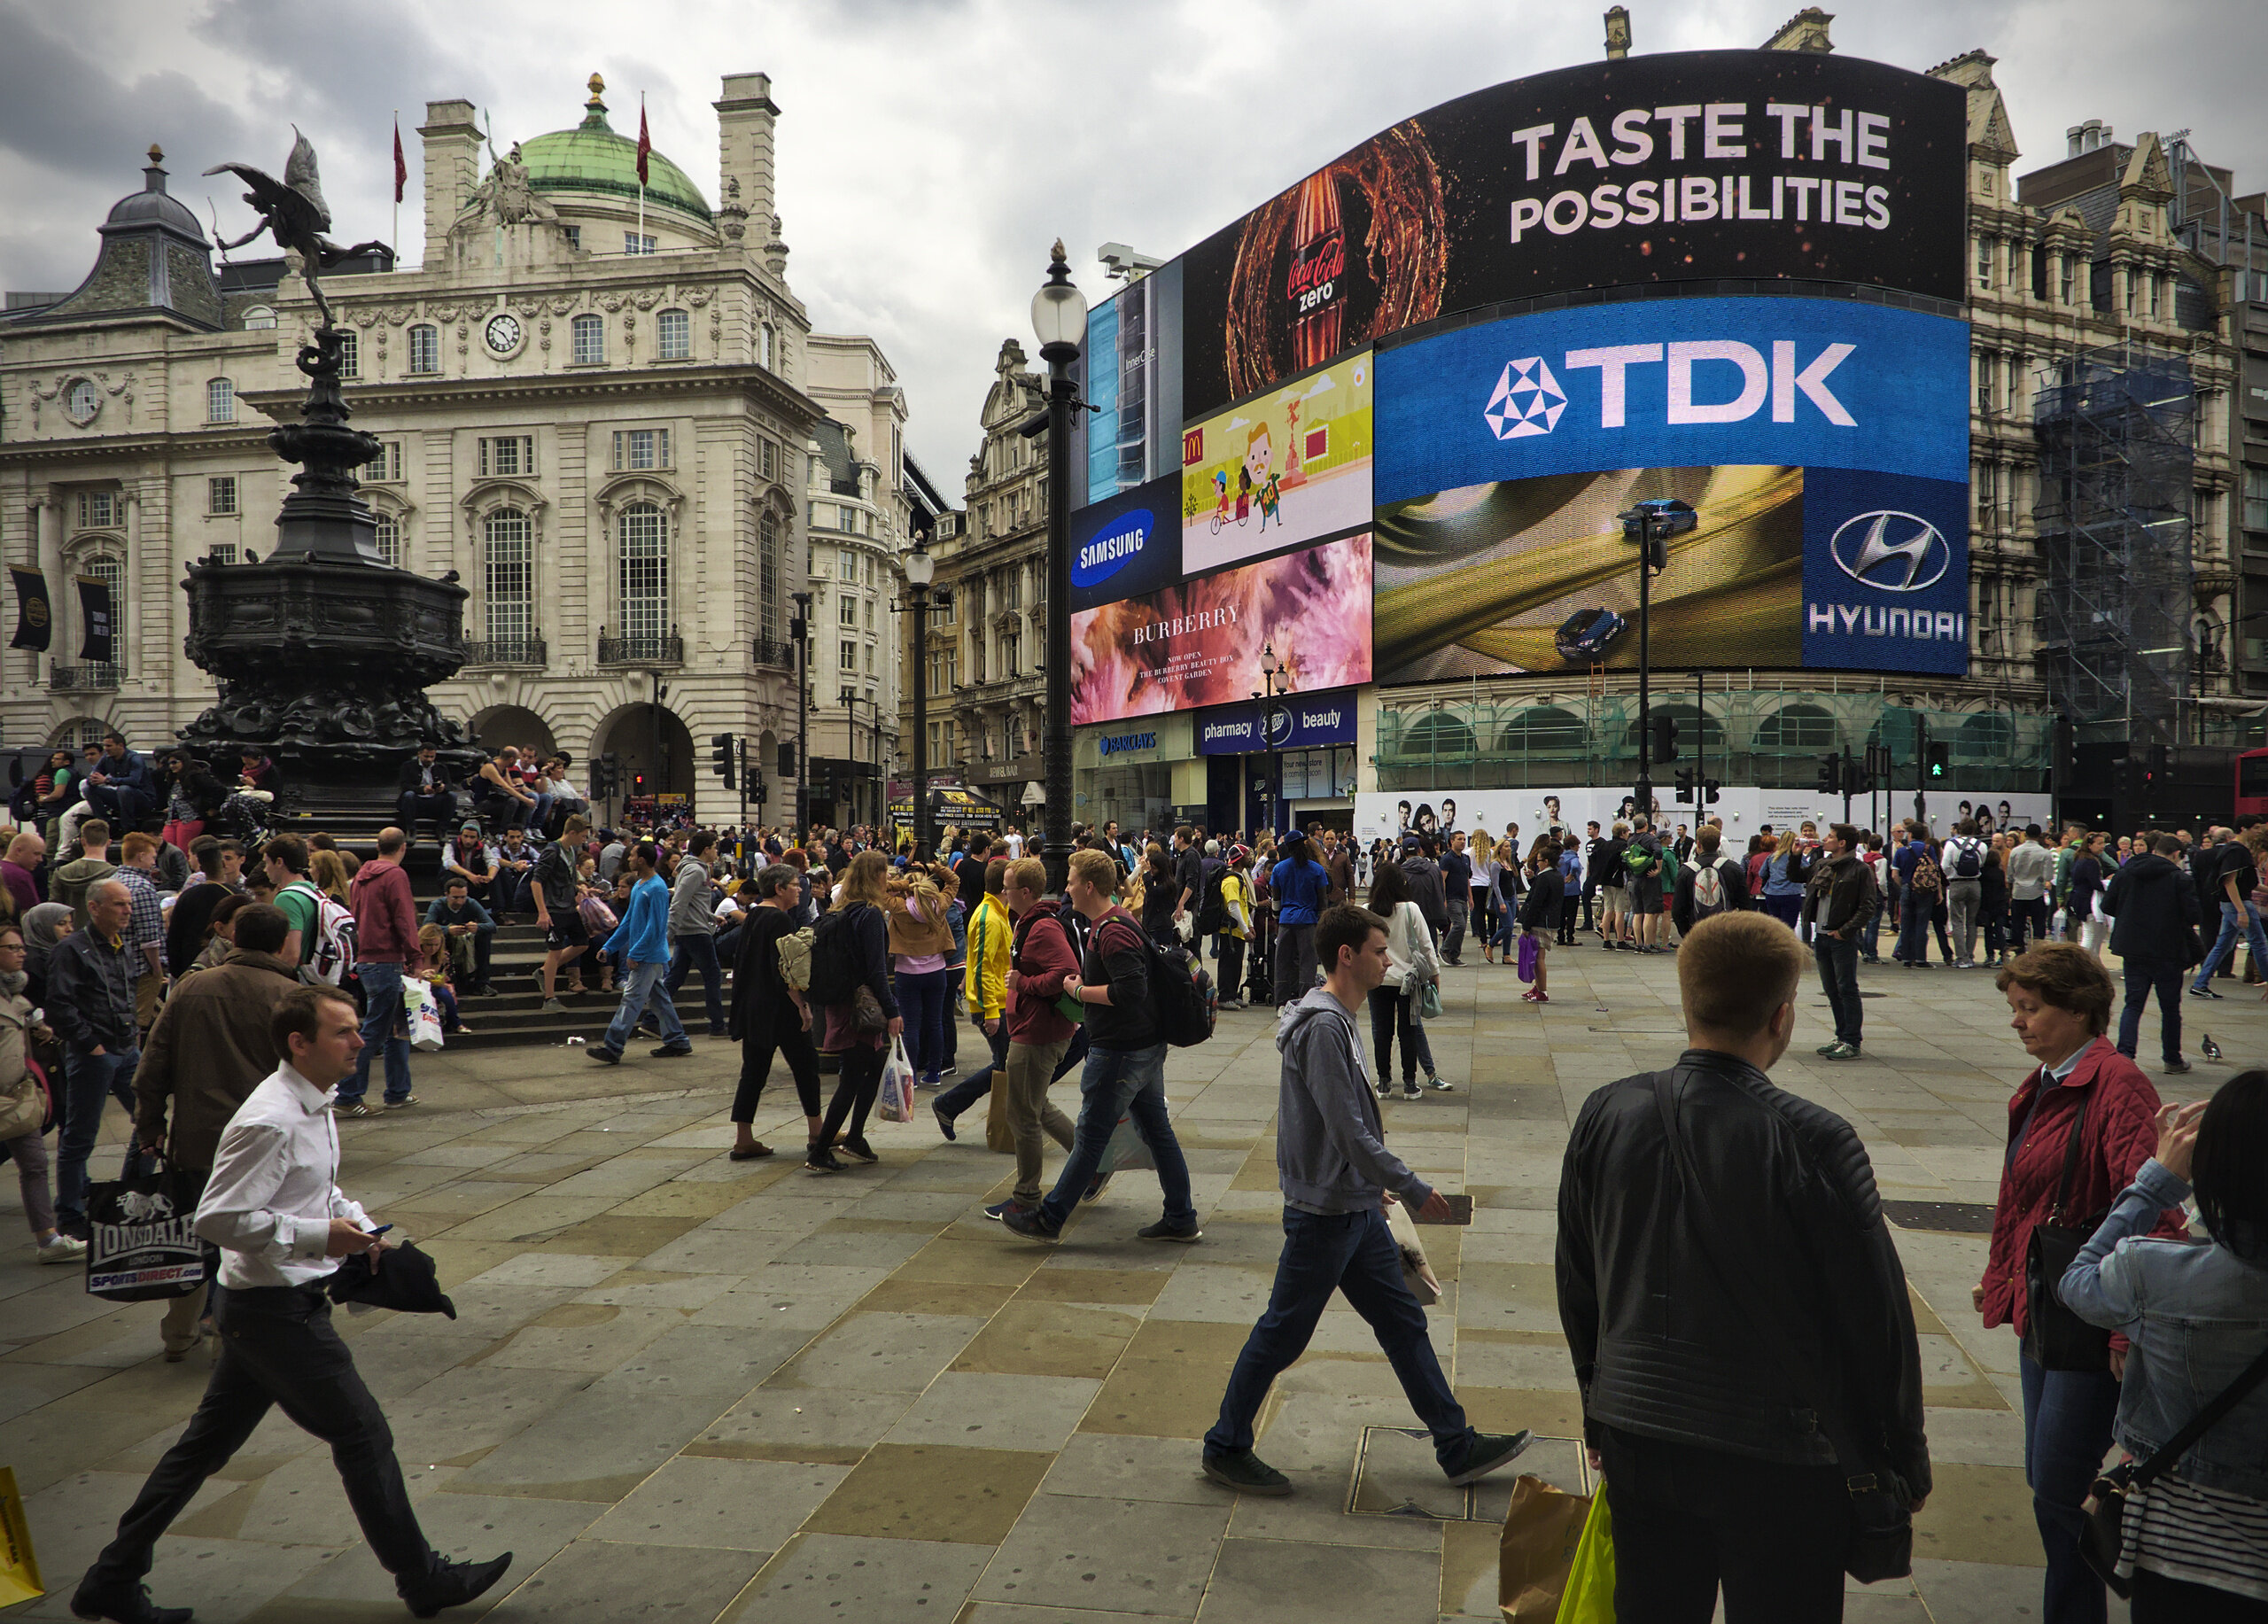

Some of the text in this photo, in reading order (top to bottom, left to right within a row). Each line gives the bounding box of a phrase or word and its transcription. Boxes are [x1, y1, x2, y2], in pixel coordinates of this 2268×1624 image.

[1511, 103, 1891, 181] TASTE THE
[1510, 175, 1891, 245] POSSIBILITIES
[1287, 233, 1345, 299] Coca-Cola
[1300, 282, 1334, 313] zero
[1565, 340, 1859, 429] TDK
[1080, 528, 1144, 570] SAMSUNG
[1133, 603, 1240, 645] BURBERRY
[1809, 602, 1964, 642] HYUNDAI
[1139, 655, 1233, 679] THE BURBERRY BEAUTY BOX
[1168, 651, 1202, 664] NOW OPEN
[1157, 669, 1212, 684] COVENT GARDEN
[1110, 731, 1156, 753] BARCLAYS
[1204, 721, 1253, 742] pharmacy
[1302, 709, 1341, 728] beauty
[128, 1254, 164, 1266] LONDON
